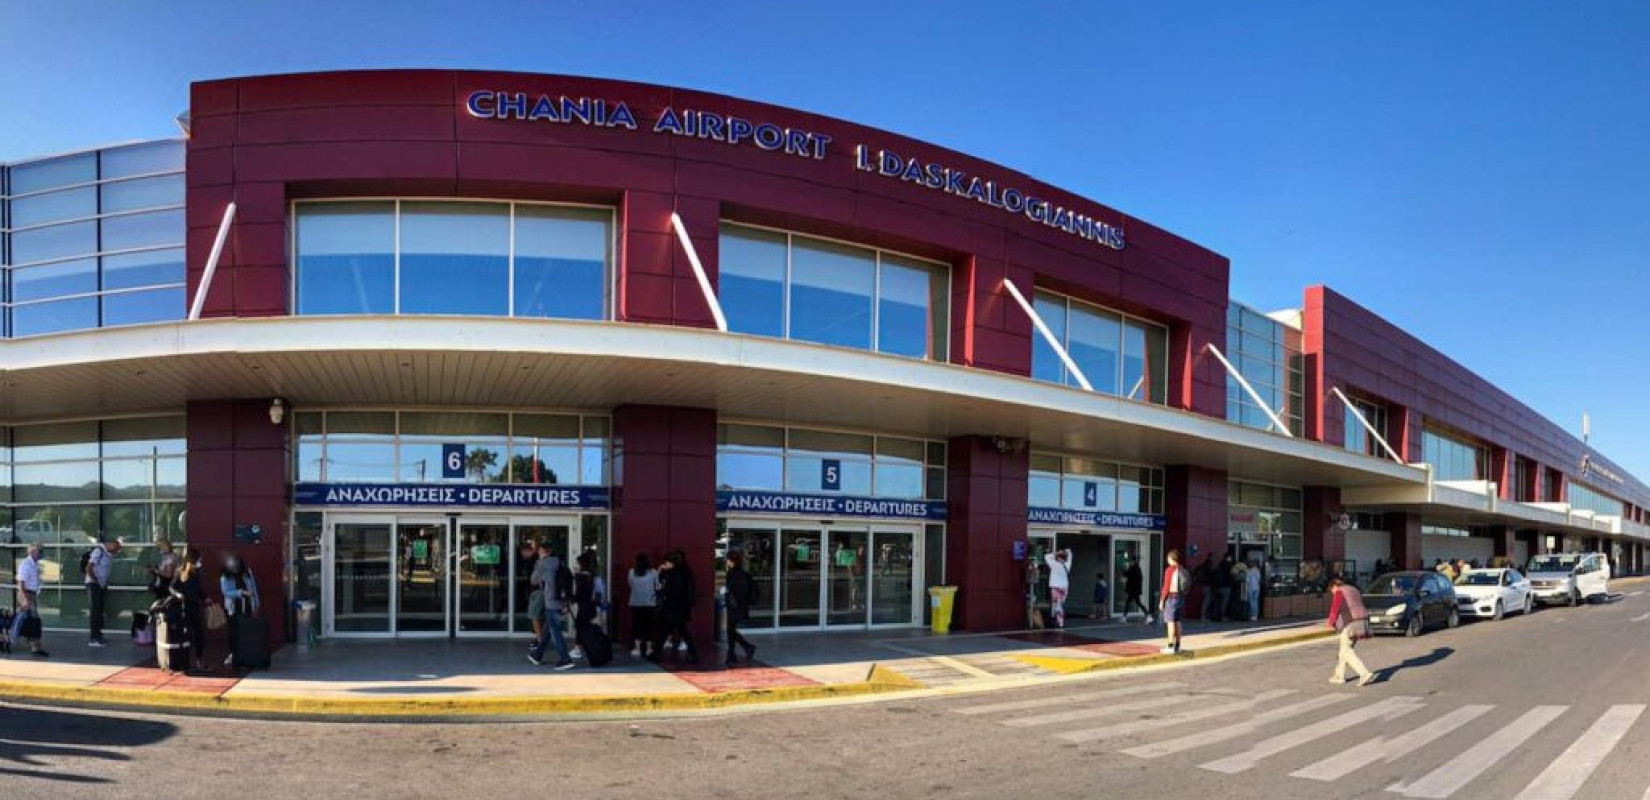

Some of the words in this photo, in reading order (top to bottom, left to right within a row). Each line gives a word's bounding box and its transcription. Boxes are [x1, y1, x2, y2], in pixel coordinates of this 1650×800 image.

[466, 90, 637, 129] CHANIA
[653, 107, 832, 160] AIRPORT
[447, 452, 461, 471] 6
[826, 466, 837, 484] 5
[326, 487, 456, 503] ΑΝΑΧΩΡΗΣΕΙΣ
[469, 488, 581, 505] DEPARTURES
[1087, 487, 1095, 502] 4
[728, 495, 836, 512] ΑΝΑΧΩΡΗΣΕΙΣ
[846, 501, 928, 516] DEPARTURES
